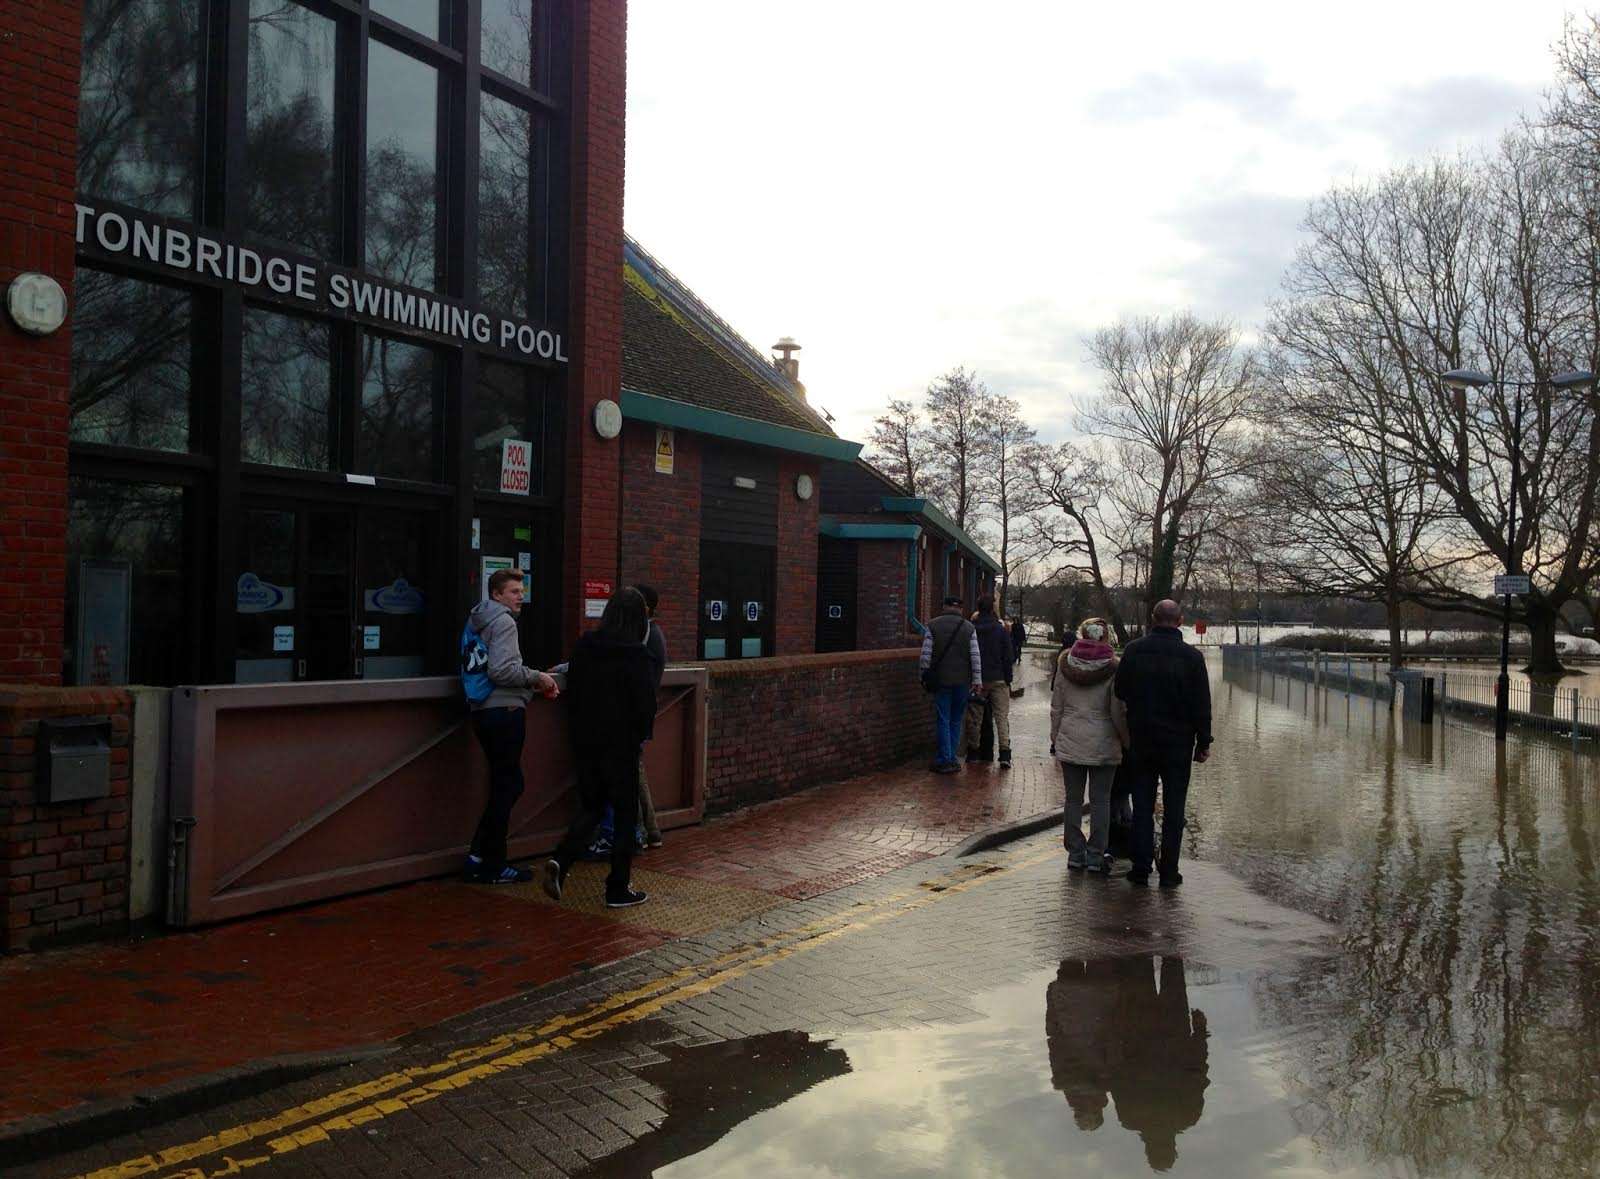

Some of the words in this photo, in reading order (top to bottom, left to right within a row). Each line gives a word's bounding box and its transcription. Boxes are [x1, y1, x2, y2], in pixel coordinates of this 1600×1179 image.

[75, 203, 317, 301] TONBRIDGE
[328, 273, 492, 344] SWIMMING
[500, 319, 569, 363] POOL
[507, 444, 526, 466] POOL
[502, 468, 529, 491] CLOSED
